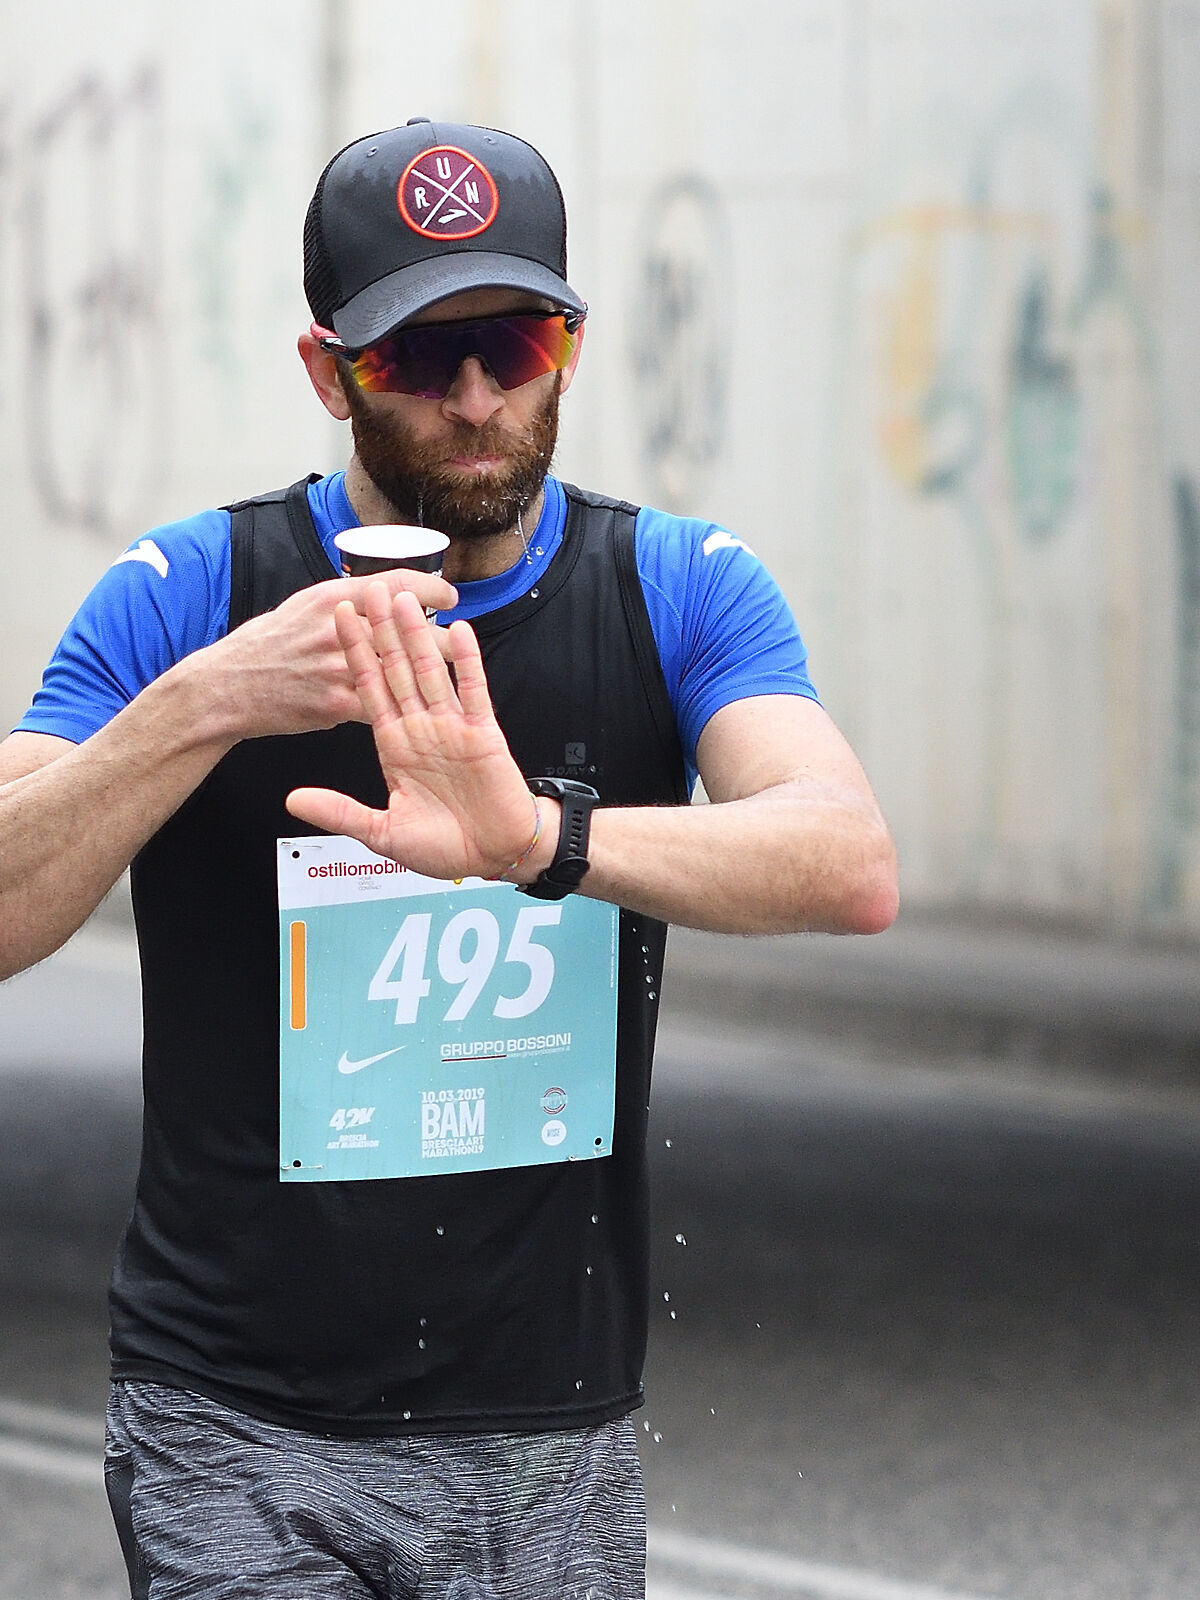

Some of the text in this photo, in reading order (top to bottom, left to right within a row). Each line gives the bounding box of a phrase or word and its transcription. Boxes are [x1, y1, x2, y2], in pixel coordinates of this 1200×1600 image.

[367, 905, 563, 1025] 495
[440, 1040, 504, 1057] GRUPPO
[506, 1032, 572, 1052] BOSSONI
[421, 1087, 485, 1104] 10.03.2019
[421, 1099, 485, 1140] BAM
